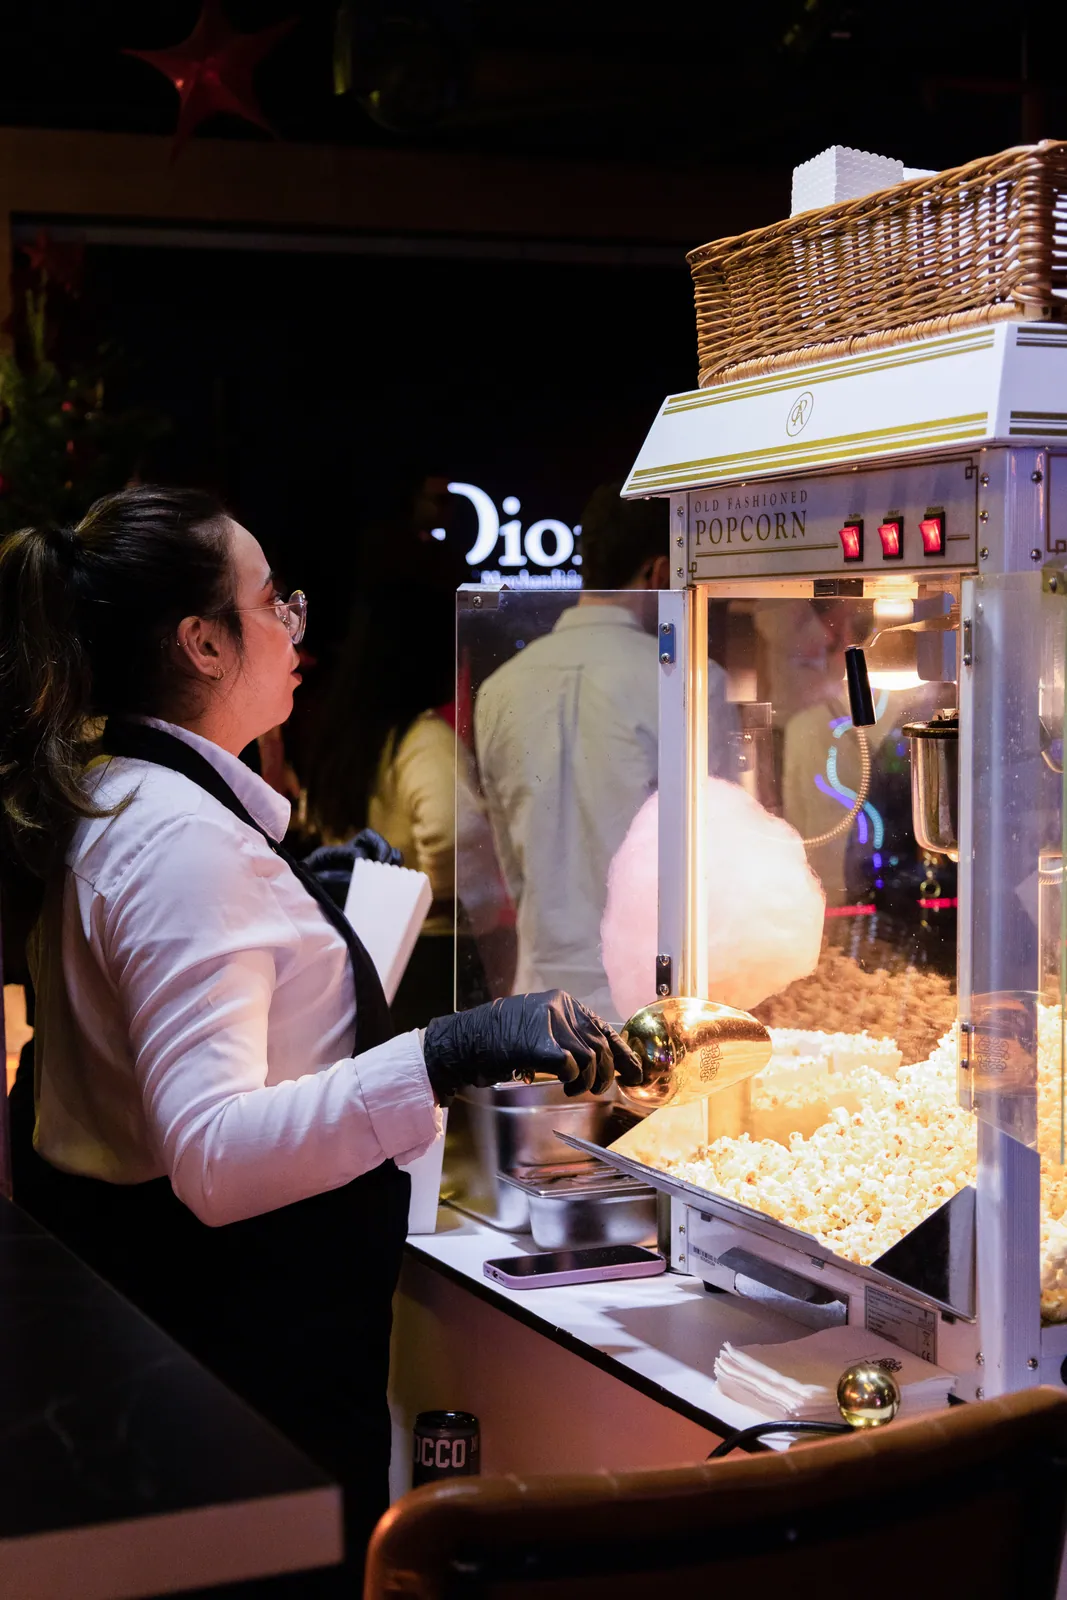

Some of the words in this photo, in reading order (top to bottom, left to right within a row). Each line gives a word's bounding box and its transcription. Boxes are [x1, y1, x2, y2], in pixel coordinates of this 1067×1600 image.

[694, 499, 720, 514] OLD
[727, 489, 808, 511] FASHIONED
[695, 509, 807, 546] POPCORN
